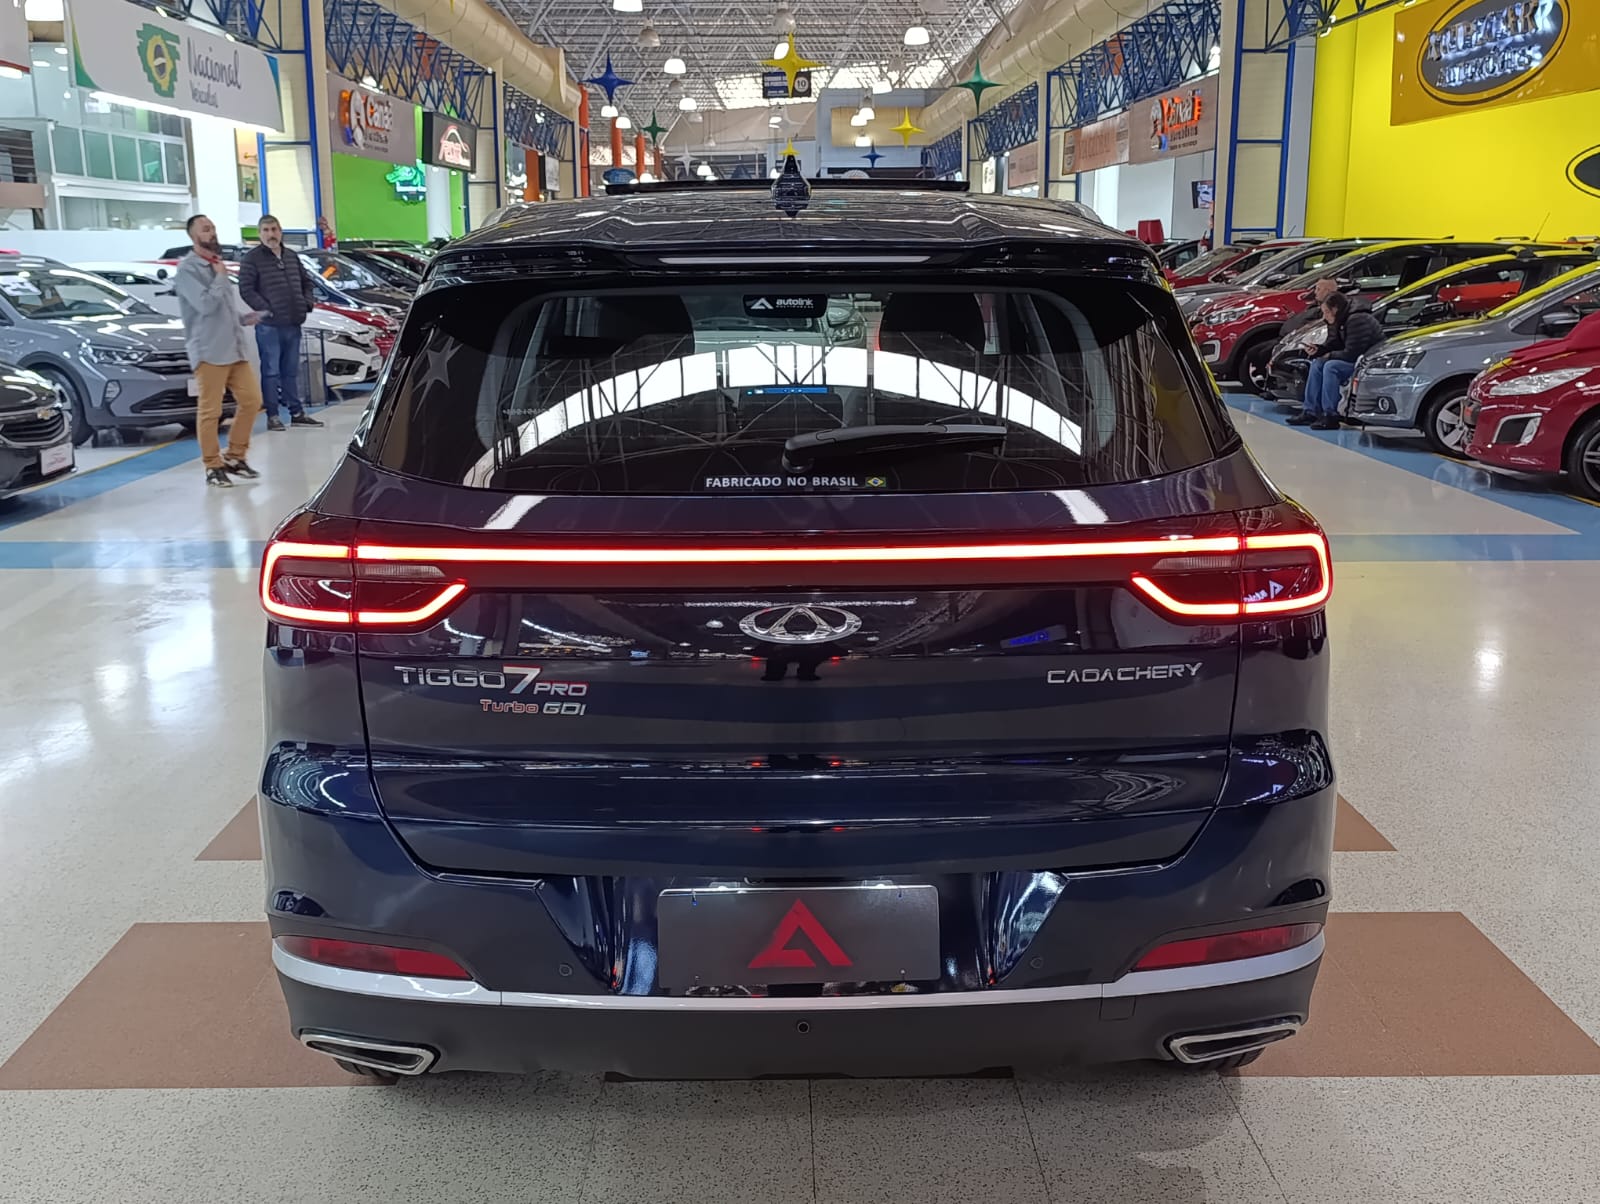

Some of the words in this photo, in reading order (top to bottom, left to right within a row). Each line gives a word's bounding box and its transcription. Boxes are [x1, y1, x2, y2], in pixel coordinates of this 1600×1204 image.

[187, 36, 242, 90] Nacional
[776, 297, 813, 306] autolink
[706, 477, 782, 488] FABRICADO
[787, 477, 807, 487] NO
[812, 476, 858, 487] BRASIL
[1116, 661, 1203, 681] CHERY
[533, 681, 588, 697] PRO
[479, 698, 539, 714] Turbo
